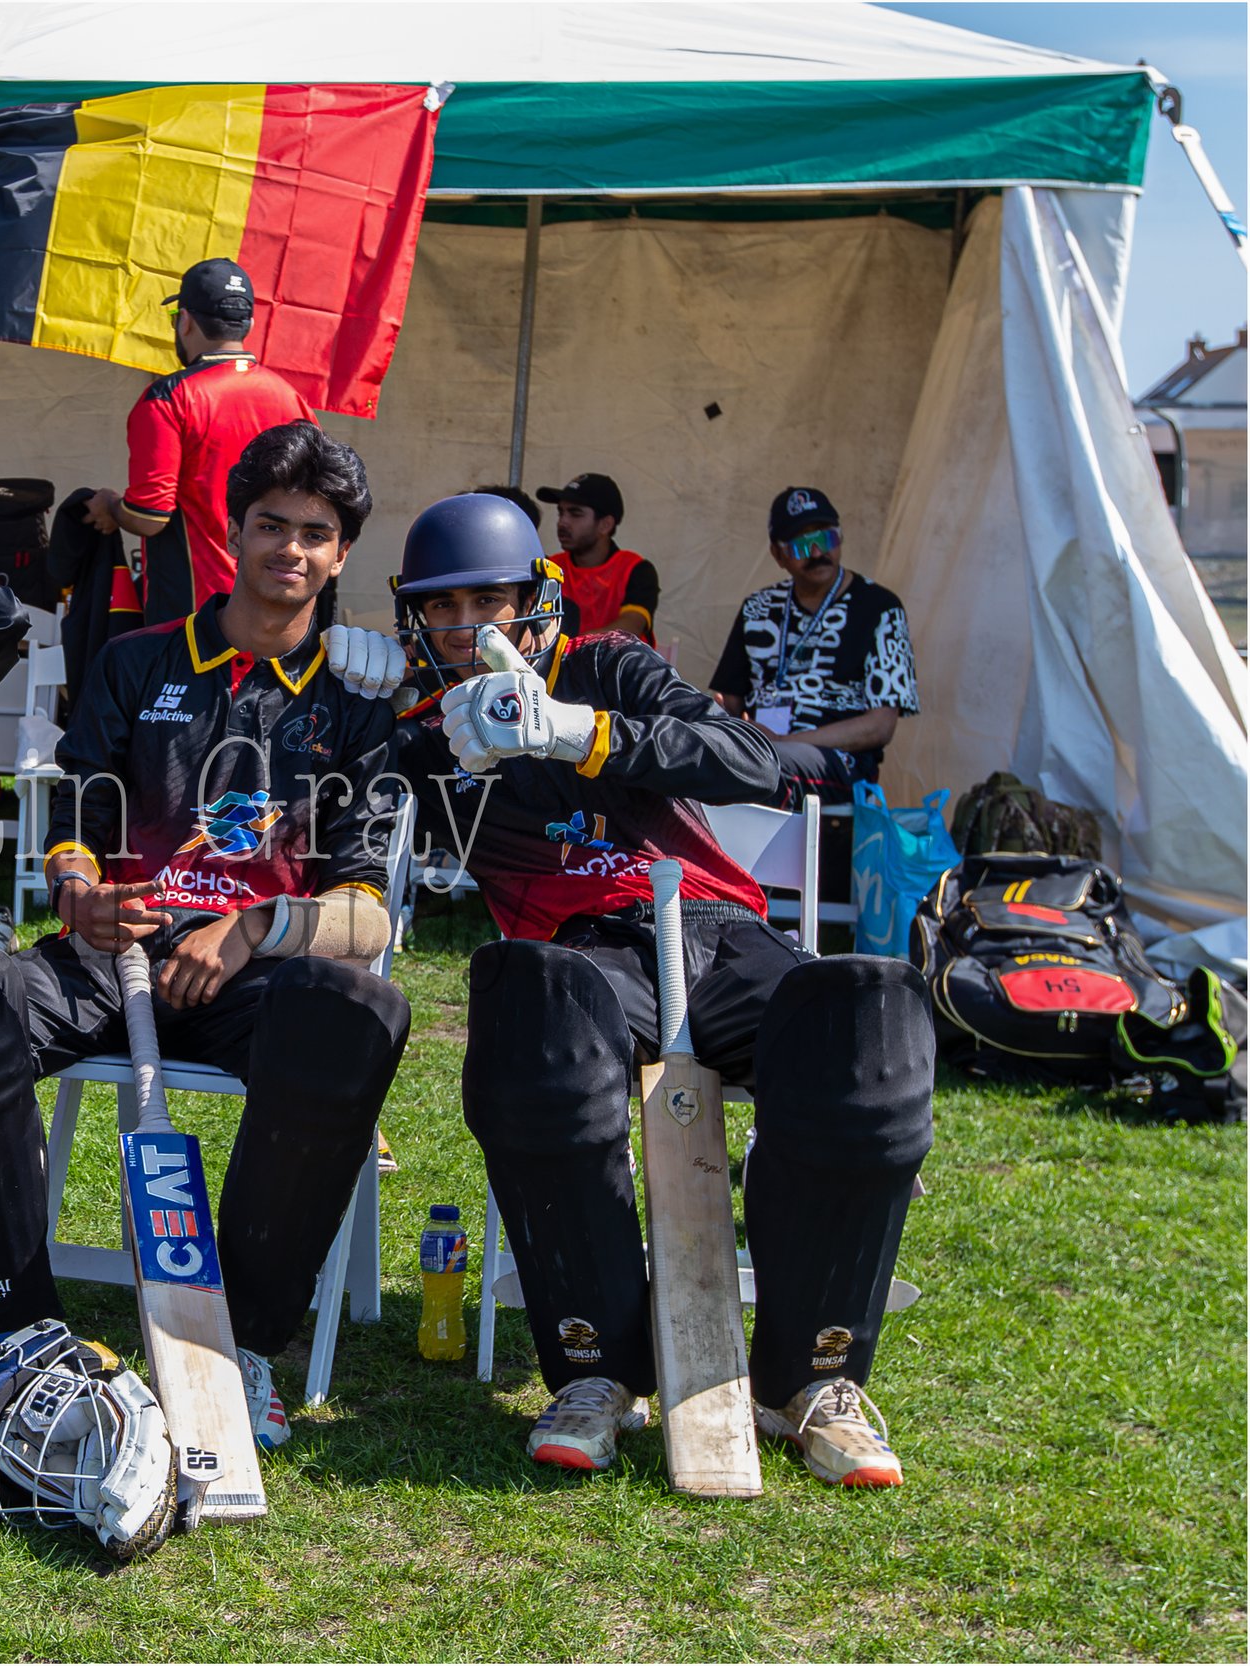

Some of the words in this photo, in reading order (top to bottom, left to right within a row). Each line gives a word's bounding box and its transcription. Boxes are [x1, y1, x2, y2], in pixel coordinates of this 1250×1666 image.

[532, 689, 540, 710] TEST
[139, 709, 193, 724] GripActive
[533, 708, 541, 732] WHITE
[153, 890, 229, 906] SPORTS
[1044, 977, 1082, 994] 54
[127, 1136, 137, 1167] Hitman
[140, 1145, 203, 1277] CEAT
[563, 1347, 603, 1359] BONSAI
[811, 1354, 848, 1366] BONSAI
